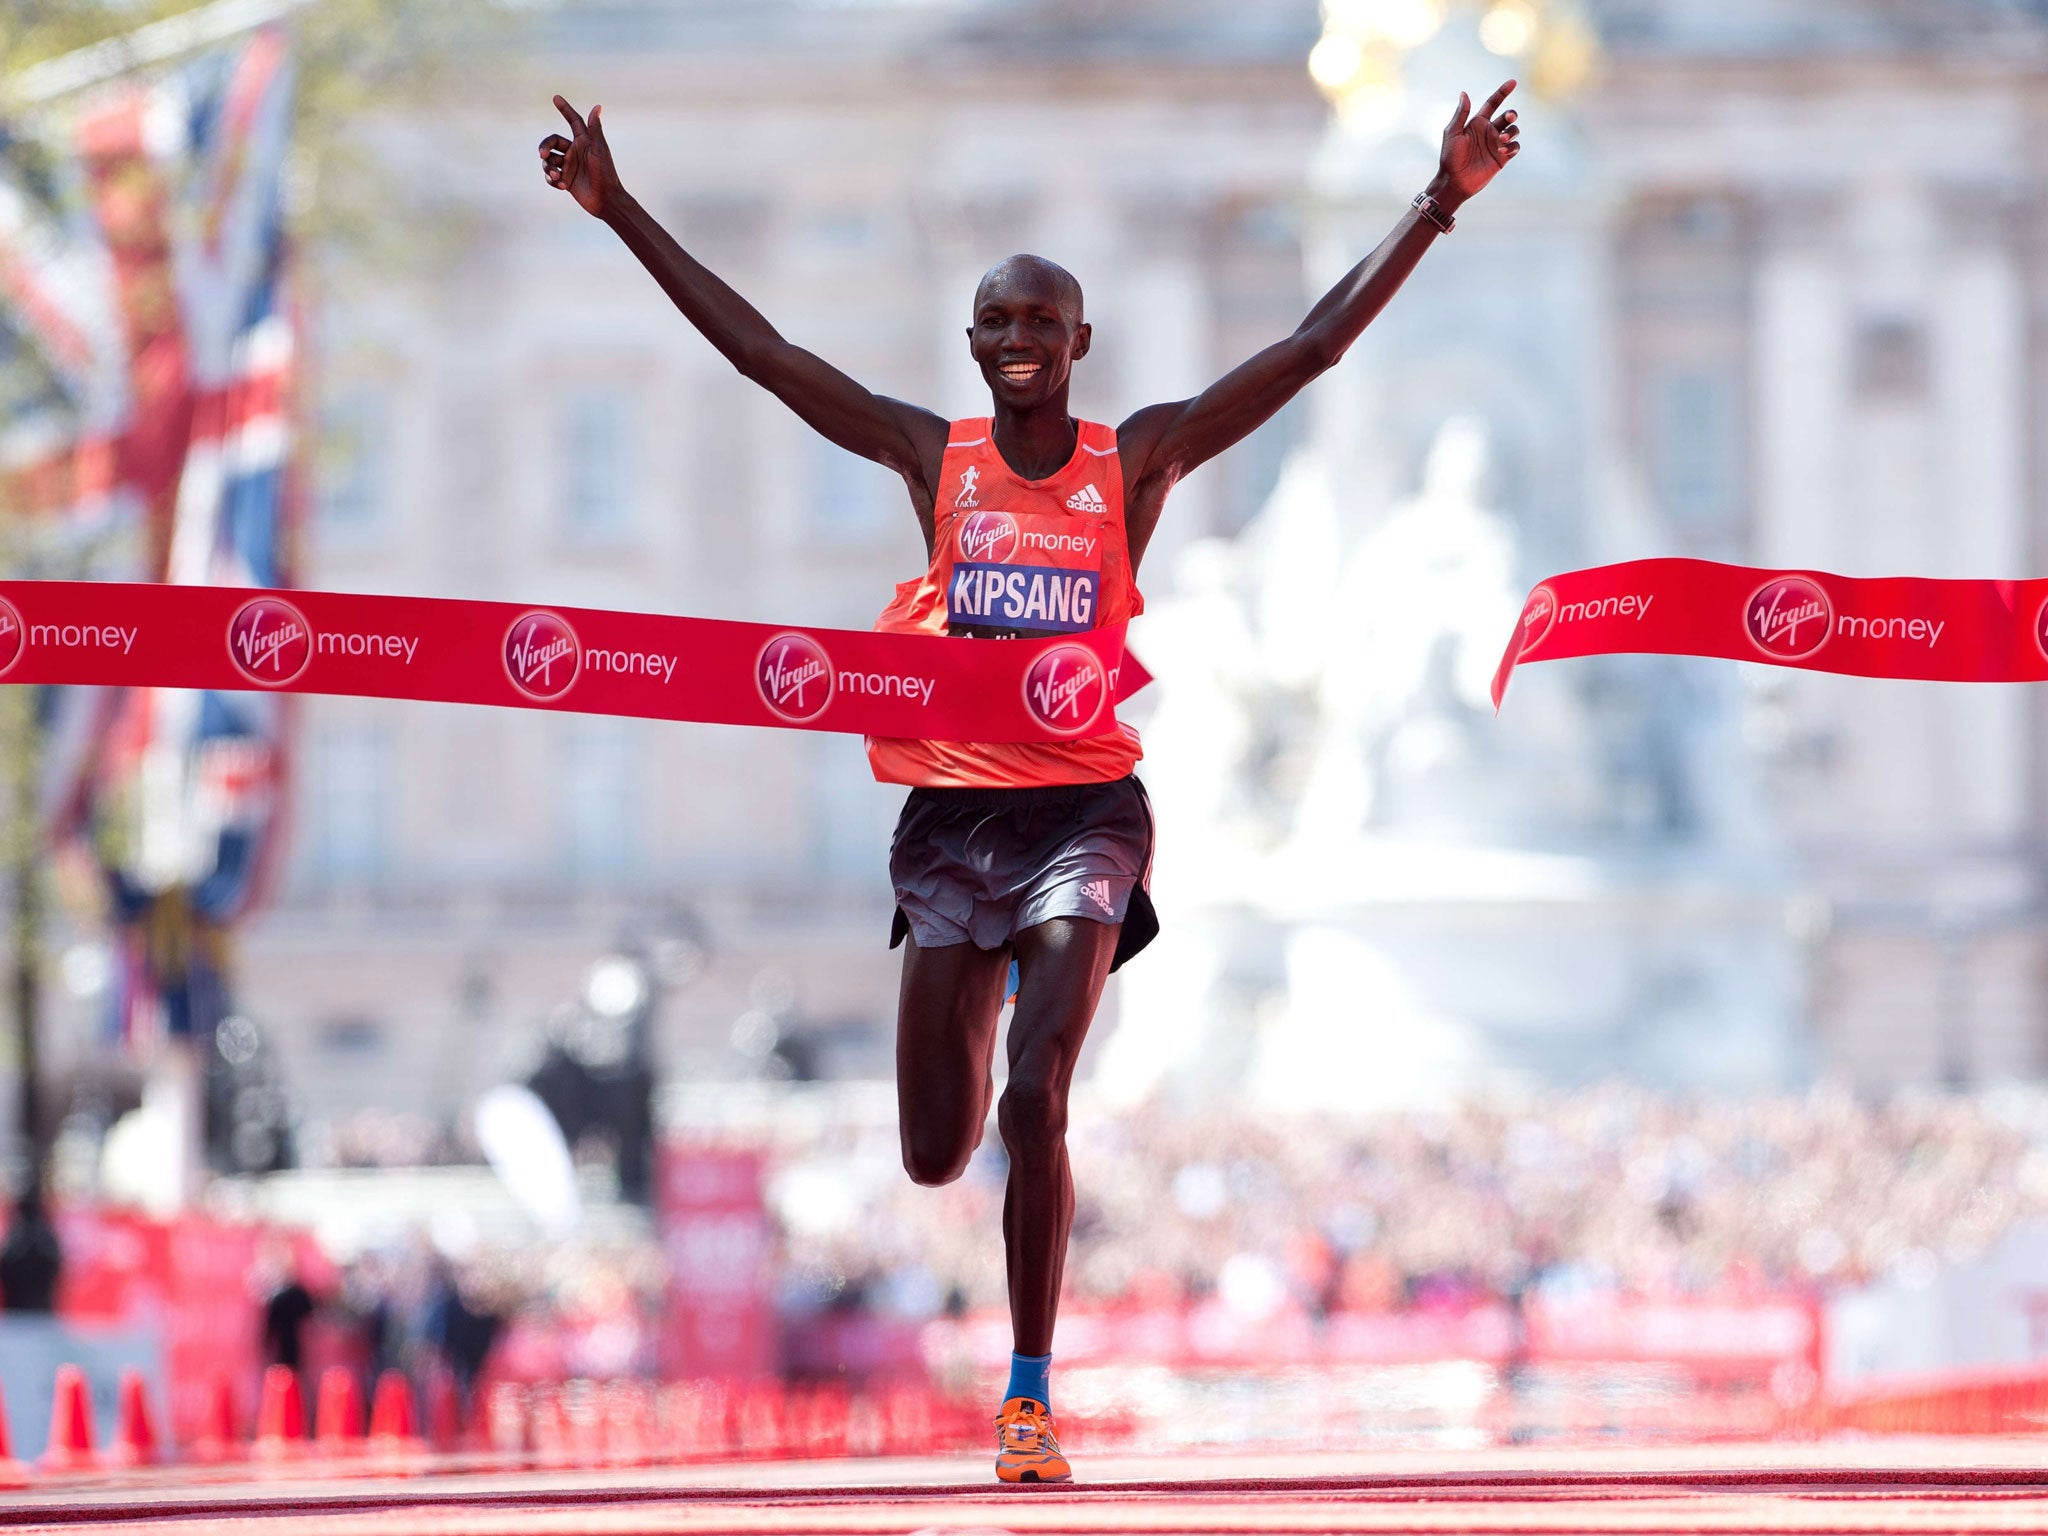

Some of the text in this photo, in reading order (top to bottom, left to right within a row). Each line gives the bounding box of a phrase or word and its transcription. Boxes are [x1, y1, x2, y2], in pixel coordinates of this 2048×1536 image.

[1066, 499, 1107, 514] adidas
[963, 513, 1097, 560] Virgin money
[954, 570, 1092, 624] KIPSANG
[1558, 594, 1654, 624] money
[1753, 587, 1944, 648] Virgin money
[31, 624, 138, 655] money
[237, 610, 419, 672] Virgin money
[512, 623, 678, 686] Virgin money
[764, 644, 936, 708] Virgin money
[1033, 658, 1097, 719] Virgin
[1080, 886, 1114, 916] adidas
